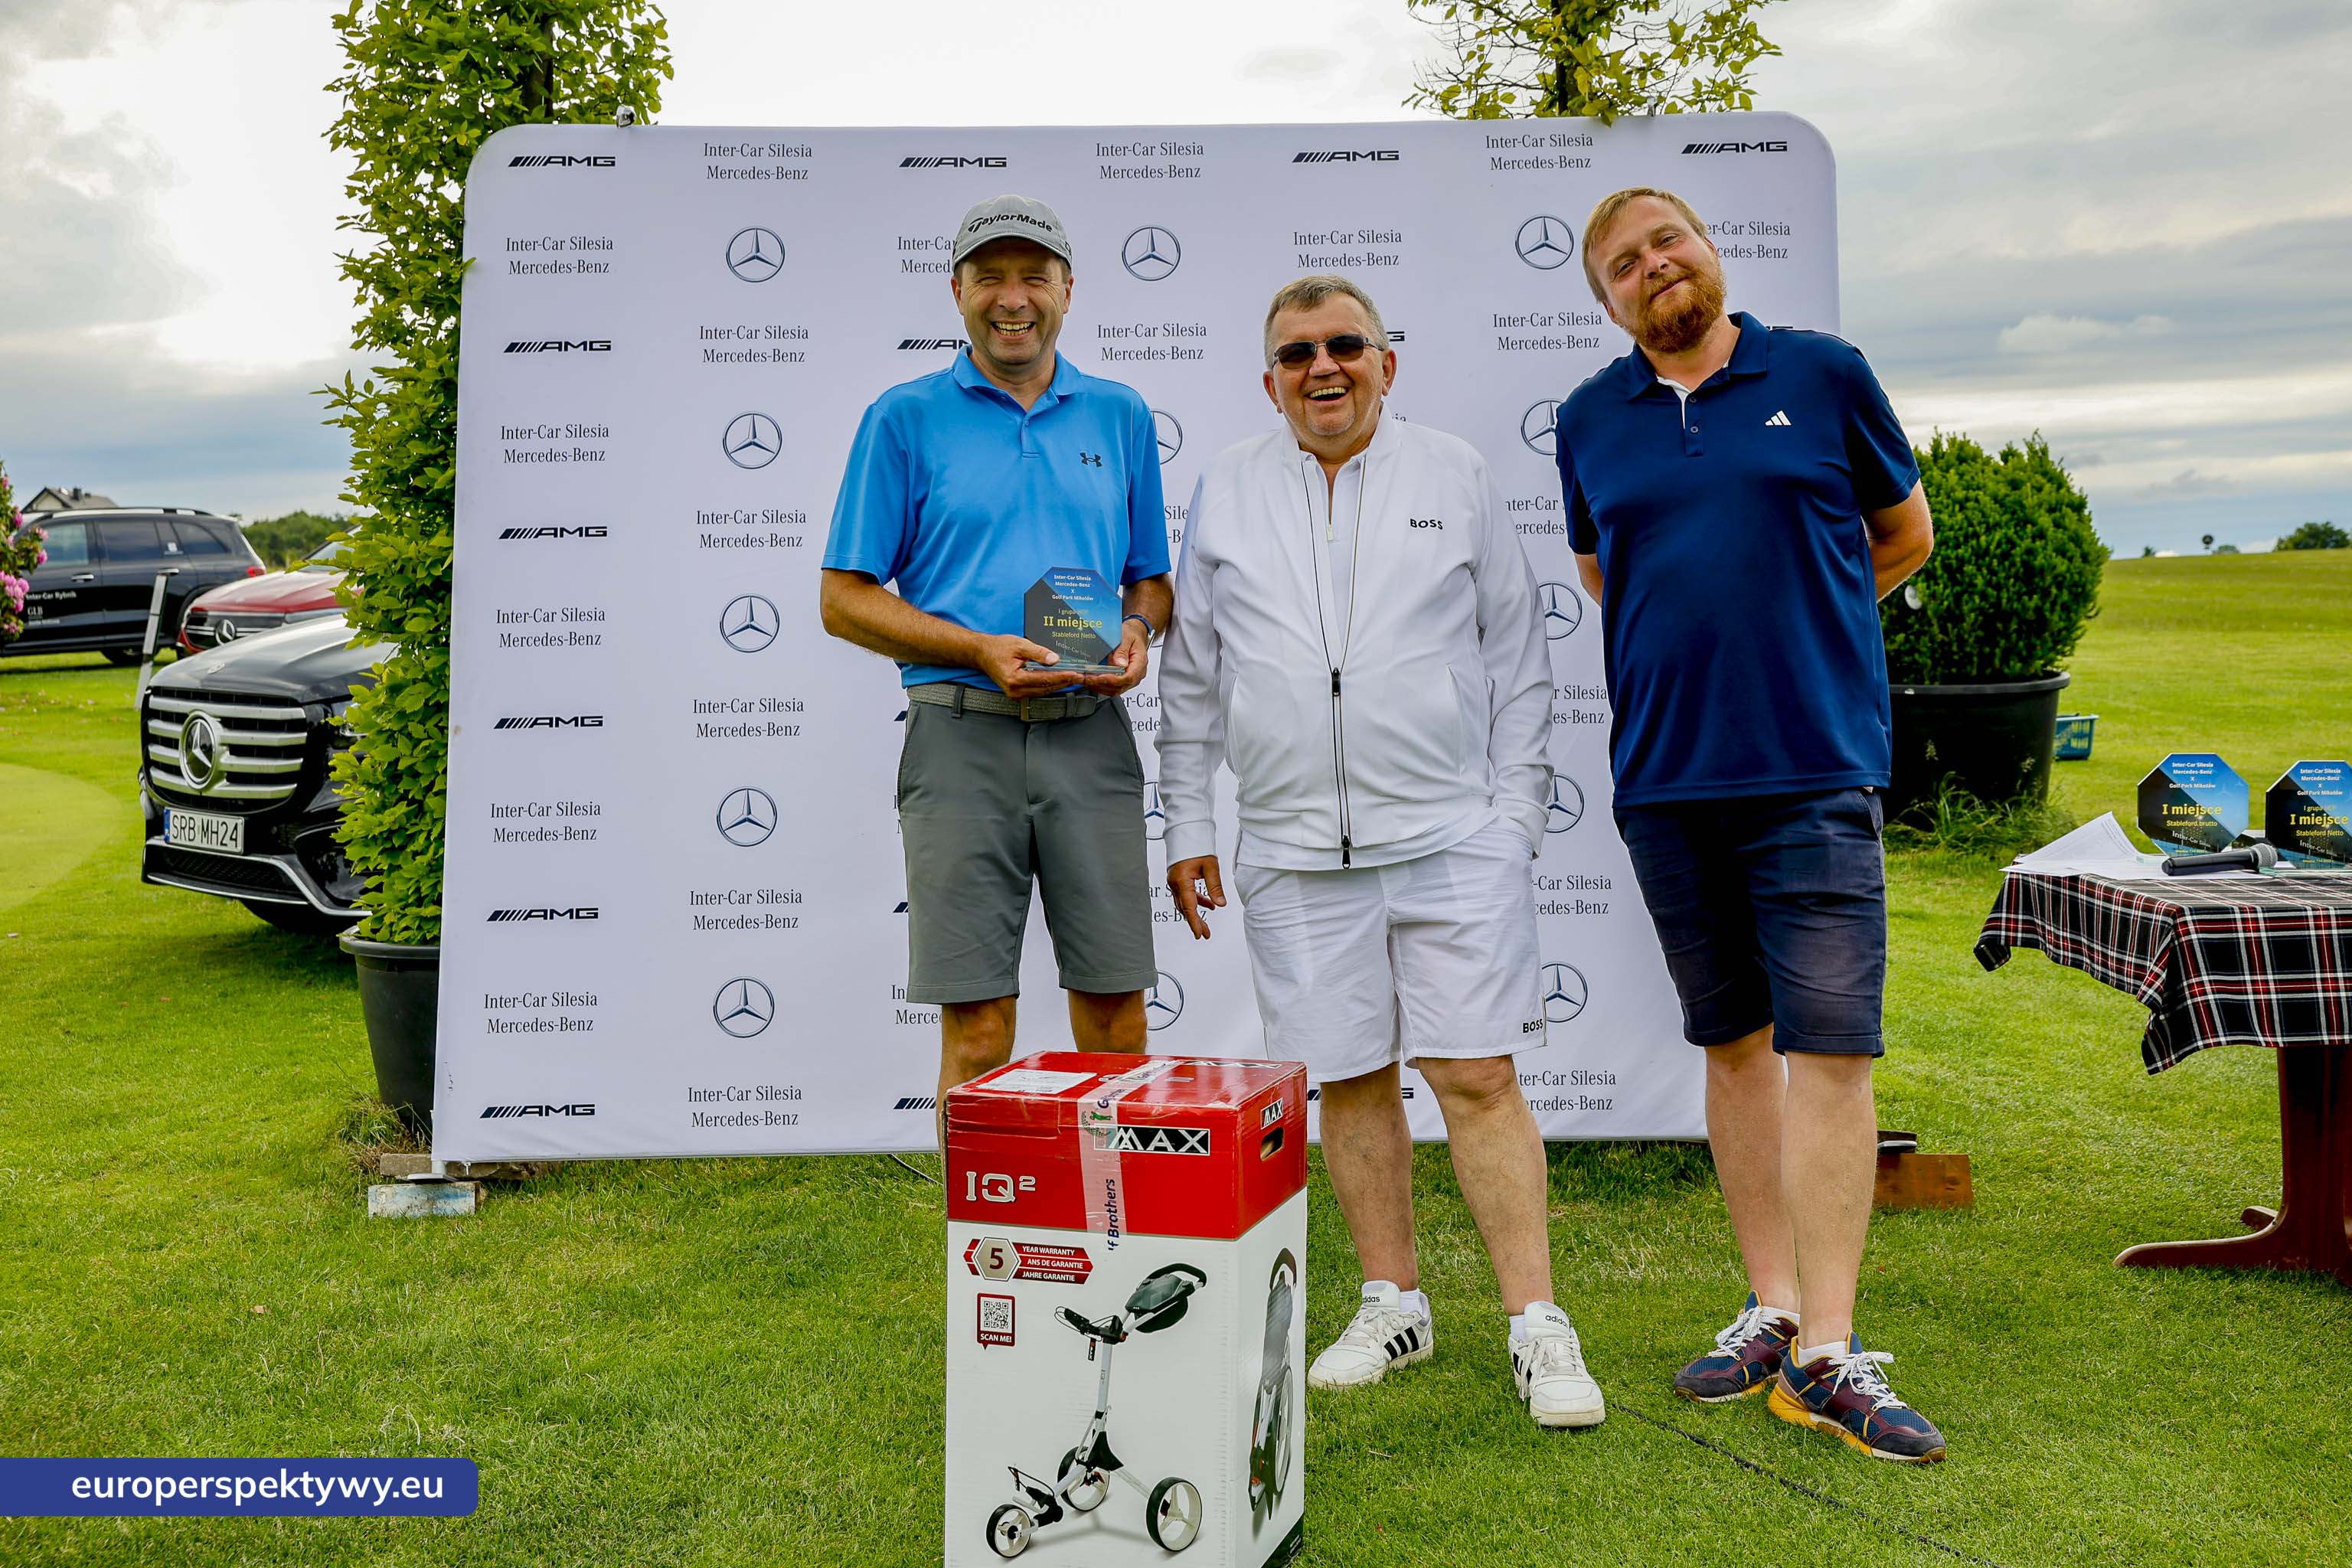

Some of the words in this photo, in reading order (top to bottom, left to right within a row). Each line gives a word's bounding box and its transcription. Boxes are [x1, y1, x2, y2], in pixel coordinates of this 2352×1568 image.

[1485, 134, 1546, 149] Inter-Car
[1549, 133, 1593, 148] Silesia
[704, 142, 765, 158] Inter-Car
[768, 143, 812, 158] Silesia
[1096, 142, 1156, 157] Inter-Car
[1160, 142, 1204, 156] Silesia
[1491, 155, 1592, 171] Mercedes-Benz
[706, 165, 808, 181] Mercedes-Benz
[1099, 164, 1201, 179] Mercedes-Benz
[967, 214, 1053, 233] TaylorMade
[1748, 220, 1792, 236] Silesia
[505, 236, 566, 252] Inter-Car
[569, 236, 613, 251] Silesia
[1293, 230, 1354, 246] Inter-Car
[1357, 229, 1402, 244] Silesia
[1717, 244, 1788, 259] cedes-Benz
[509, 259, 609, 275] Mercedes-Benz
[1298, 252, 1400, 268] Mercedes-Benz
[1493, 312, 1554, 328] Inter-Car
[1557, 311, 1602, 327] Silesia
[700, 325, 760, 340] Inter-Car
[764, 325, 809, 340] Silesia
[1097, 323, 1158, 338] Inter-Car
[1162, 322, 1207, 338] Silesia
[1497, 335, 1600, 351] Mercedes-Benz
[702, 348, 805, 363] Mercedes-Benz
[1101, 345, 1204, 361] Mercedes-Benz
[501, 424, 561, 440] Inter-Car
[565, 423, 609, 439] Silesia
[504, 447, 606, 464] Mercedes-Benz
[697, 509, 758, 525] Inter-Car
[761, 509, 807, 524] Silesia
[1164, 505, 1189, 520] Sile
[1410, 518, 1443, 530] BOSS
[699, 533, 802, 549] Mercedes-Benz
[496, 607, 557, 624] Inter-Car
[560, 606, 606, 622] Silesia
[1043, 616, 1054, 626] II
[1057, 616, 1102, 630] miejsce
[499, 631, 602, 648] Mercedes-Benz
[1563, 684, 1608, 700] Silesia
[693, 697, 755, 714] Inter-Car
[759, 697, 805, 713] Silesia
[1553, 709, 1605, 724] es-Benz
[696, 721, 801, 738] Mercedes-Benz
[490, 802, 552, 818] Inter-Car
[556, 801, 601, 817] Silesia
[2161, 804, 2168, 815] I
[2171, 803, 2223, 818] miejsce
[2290, 813, 2296, 825] I
[2299, 812, 2350, 828] miejsce
[172, 815, 196, 841] SRB
[201, 818, 238, 848] MH24
[493, 825, 597, 843] Mercedes-Benz
[1566, 874, 1612, 890] Silesia
[690, 889, 753, 906] Inter-Car
[756, 888, 802, 905] Silesia
[693, 913, 799, 930] Mercedes-Benz
[483, 992, 547, 1009] Inter-Car
[551, 991, 598, 1008] Silesia
[486, 1016, 594, 1034] Mercedes-Benz
[1522, 1018, 1544, 1034] BOSS
[1518, 1070, 1567, 1086] ter-Car
[1570, 1070, 1617, 1086] Silesia
[688, 1086, 752, 1102] Inter-Car
[756, 1085, 802, 1102] Silesia
[691, 1110, 799, 1128] Mercedes-Benz
[1263, 1099, 1283, 1126] MAX
[1108, 1126, 1208, 1154] MAX
[1104, 1178, 1119, 1238] Brothers
[989, 1246, 1004, 1270] 5
[1022, 1246, 1039, 1254] YEAR
[1039, 1246, 1075, 1256] WARRANTY
[1027, 1258, 1040, 1266] ANS
[1041, 1259, 1050, 1267] DE
[1050, 1259, 1083, 1269] GARANTIE
[1022, 1271, 1043, 1280] JAHRE
[1043, 1272, 1076, 1282] GARANTIE
[980, 1333, 998, 1342] SCAN
[998, 1334, 1012, 1343] ME!
